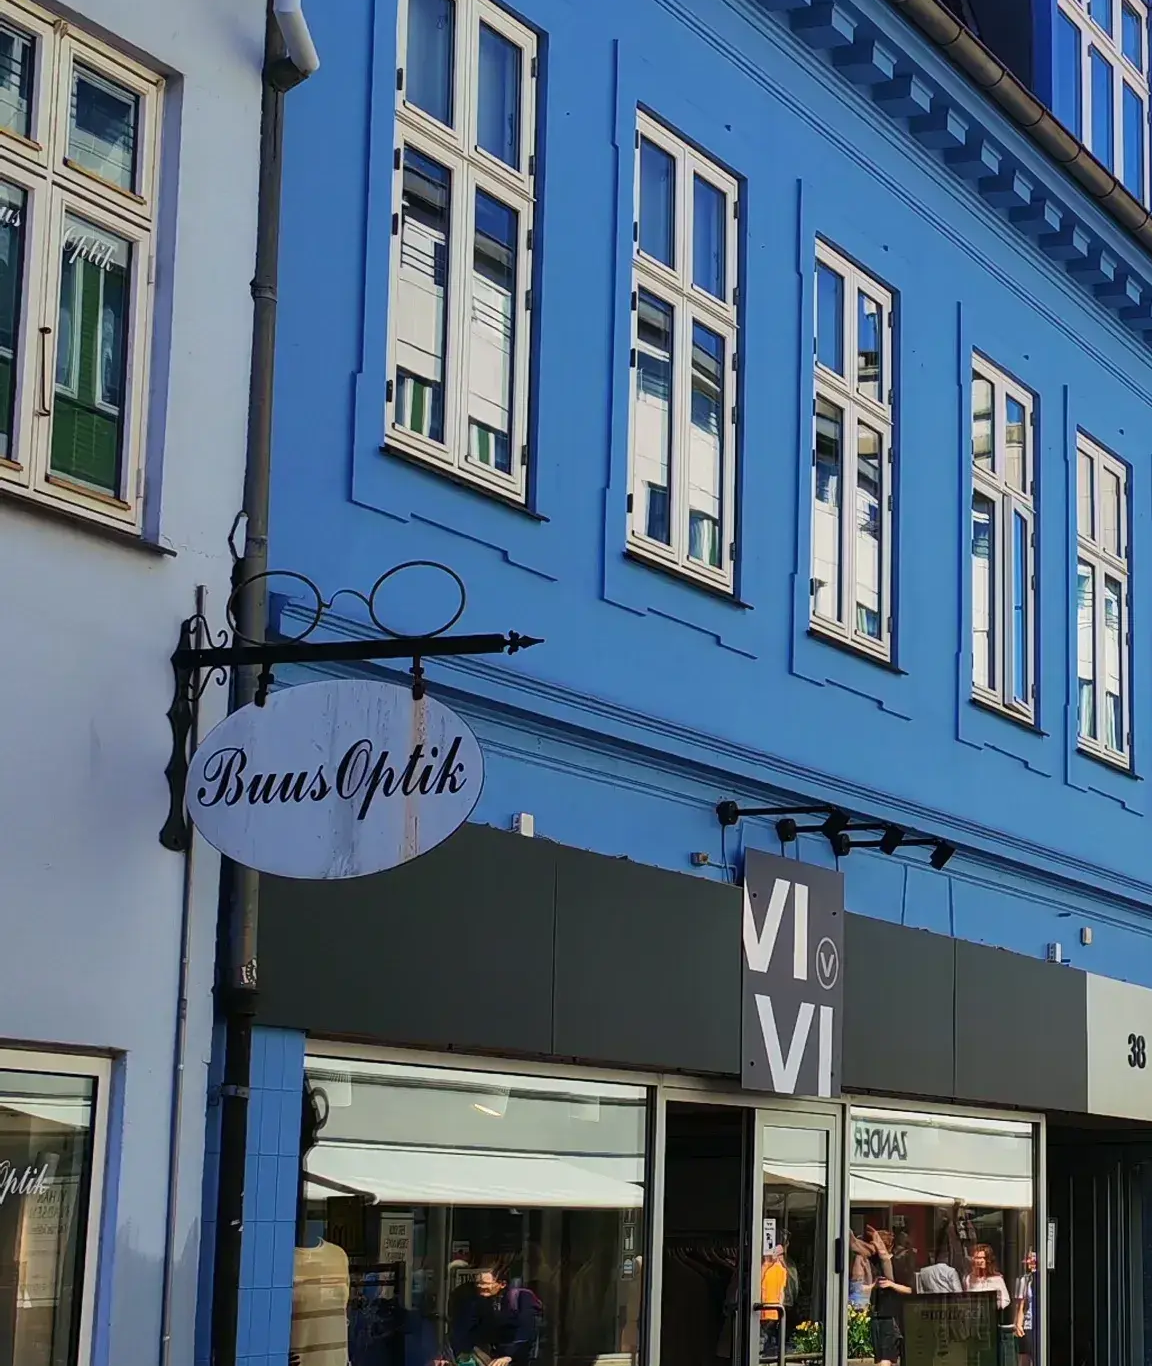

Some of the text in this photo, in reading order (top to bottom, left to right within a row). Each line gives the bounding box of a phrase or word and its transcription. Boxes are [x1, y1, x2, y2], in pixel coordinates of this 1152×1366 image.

[63, 225, 116, 272] Optik
[743, 878, 808, 981] VI
[755, 994, 833, 1098] VI
[1128, 1033, 1147, 1069] 38
